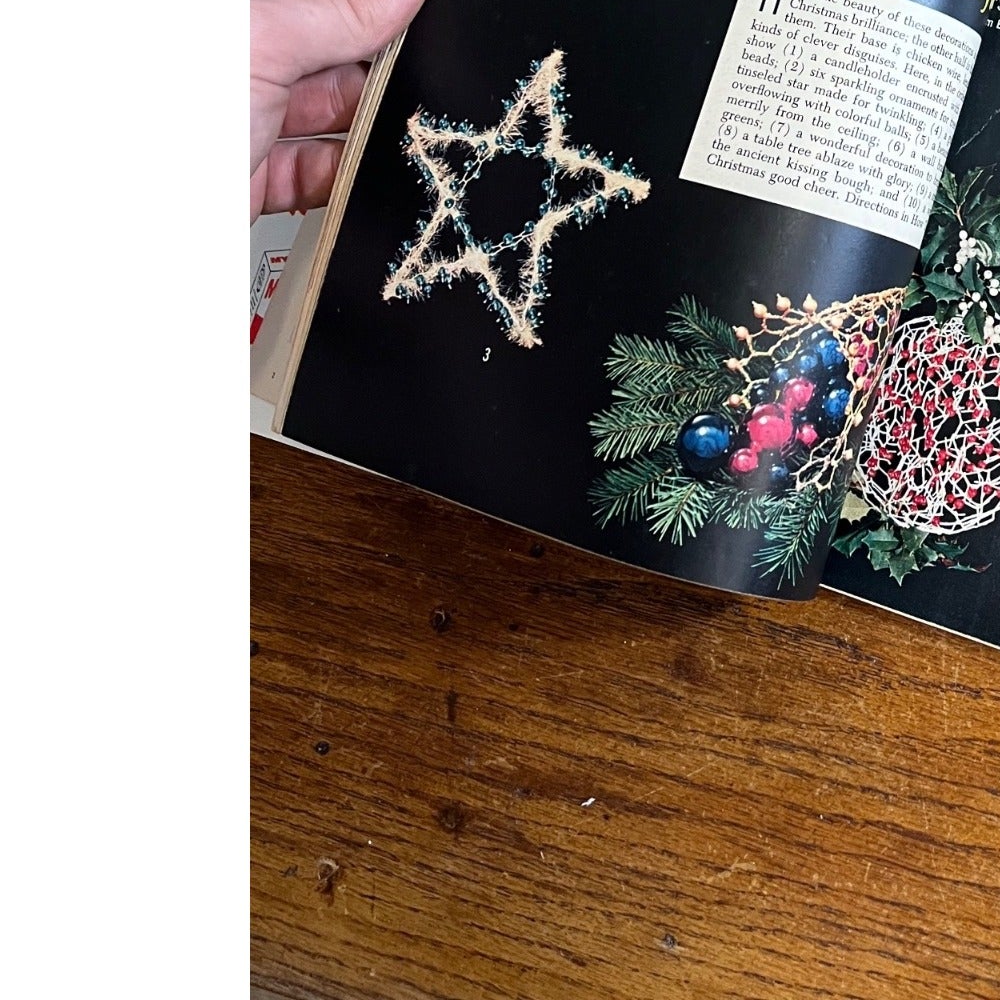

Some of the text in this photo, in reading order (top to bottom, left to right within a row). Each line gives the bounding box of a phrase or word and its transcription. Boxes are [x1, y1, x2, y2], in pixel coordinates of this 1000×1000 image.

[784, 13, 816, 29] them.
[824, 21, 856, 40] Their
[861, 32, 887, 49] base
[891, 43, 901, 55] is
[906, 49, 943, 71] chicken
[851, 14, 910, 43] brilliance;
[912, 34, 928, 48] the
[931, 44, 953, 60] other
[888, 11, 901, 21] of
[904, 16, 931, 33] these
[741, 48, 778, 69] beads;
[784, 59, 805, 76] (2)
[810, 68, 826, 80] six
[830, 74, 886, 101] sparkling
[889, 93, 938, 119] ornaments
[746, 34, 776, 50] show
[783, 43, 804, 60] (1)
[810, 53, 817, 61] a
[825, 57, 900, 87] candleholder
[906, 83, 949, 107] encrusted
[750, 19, 782, 36] kinds
[786, 29, 800, 40] of
[803, 33, 839, 51] clever
[843, 44, 898, 70] disguises.
[903, 63, 930, 84] Here,
[934, 76, 942, 88] in
[945, 81, 956, 95] the
[726, 96, 769, 115] merrily
[775, 105, 804, 122] from
[811, 116, 831, 130] the
[837, 125, 880, 147] ceiling;
[887, 139, 905, 156] (6)
[910, 150, 916, 158] a
[731, 81, 800, 108] overflowing
[805, 100, 831, 114] with
[835, 109, 881, 129] colorful
[884, 121, 912, 141] balls;
[915, 133, 929, 150] (5)
[737, 65, 783, 84] tinseled
[787, 79, 809, 91] star
[814, 89, 848, 102] made
[852, 94, 871, 109] for
[876, 103, 926, 132] twinkling;
[930, 123, 943, 139] (4)
[712, 138, 731, 152] the
[736, 147, 780, 166] ancient
[786, 157, 829, 182] kissing
[834, 171, 874, 195] bough;
[880, 190, 899, 202] and
[904, 194, 921, 213] (10)
[718, 123, 738, 140] (8)
[742, 132, 749, 141] a
[754, 133, 784, 150] table
[788, 142, 812, 157] tree
[815, 150, 854, 170] ablaze
[859, 164, 883, 180] with
[886, 173, 913, 193] glory;
[916, 182, 928, 199] (9)
[720, 110, 763, 129] greens;
[770, 120, 791, 137] (7)
[796, 130, 802, 138] a
[810, 133, 871, 158] wonderful
[875, 151, 924, 178] decoration
[706, 153, 766, 179] Christmas
[768, 172, 801, 188] good
[804, 180, 839, 200] cheer.
[845, 191, 899, 219] Directions
[900, 212, 909, 223] in
[482, 347, 491, 362] 3
